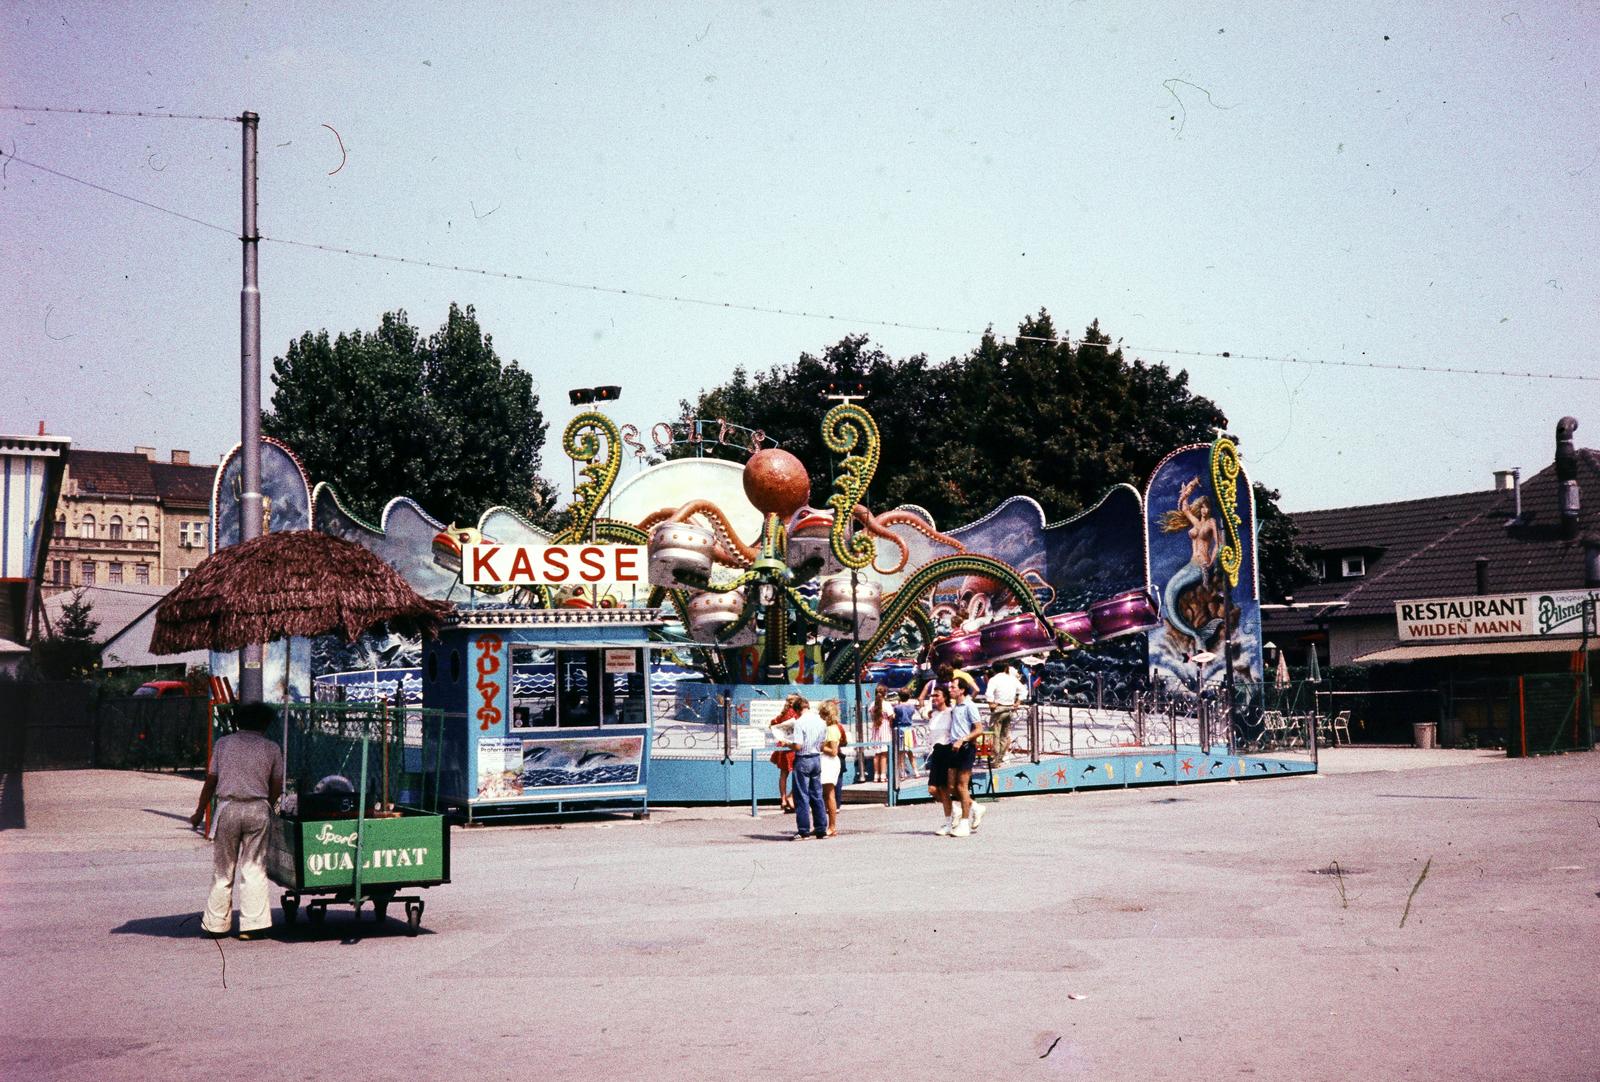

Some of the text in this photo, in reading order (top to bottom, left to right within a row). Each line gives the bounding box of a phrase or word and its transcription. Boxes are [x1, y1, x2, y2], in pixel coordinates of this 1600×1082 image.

[472, 546, 639, 582] KASSE
[1401, 598, 1527, 621] RESTAURANT
[1538, 595, 1584, 634] Pilsne
[1408, 619, 1522, 637] WILDEN MANN
[475, 633, 502, 731] POLYP
